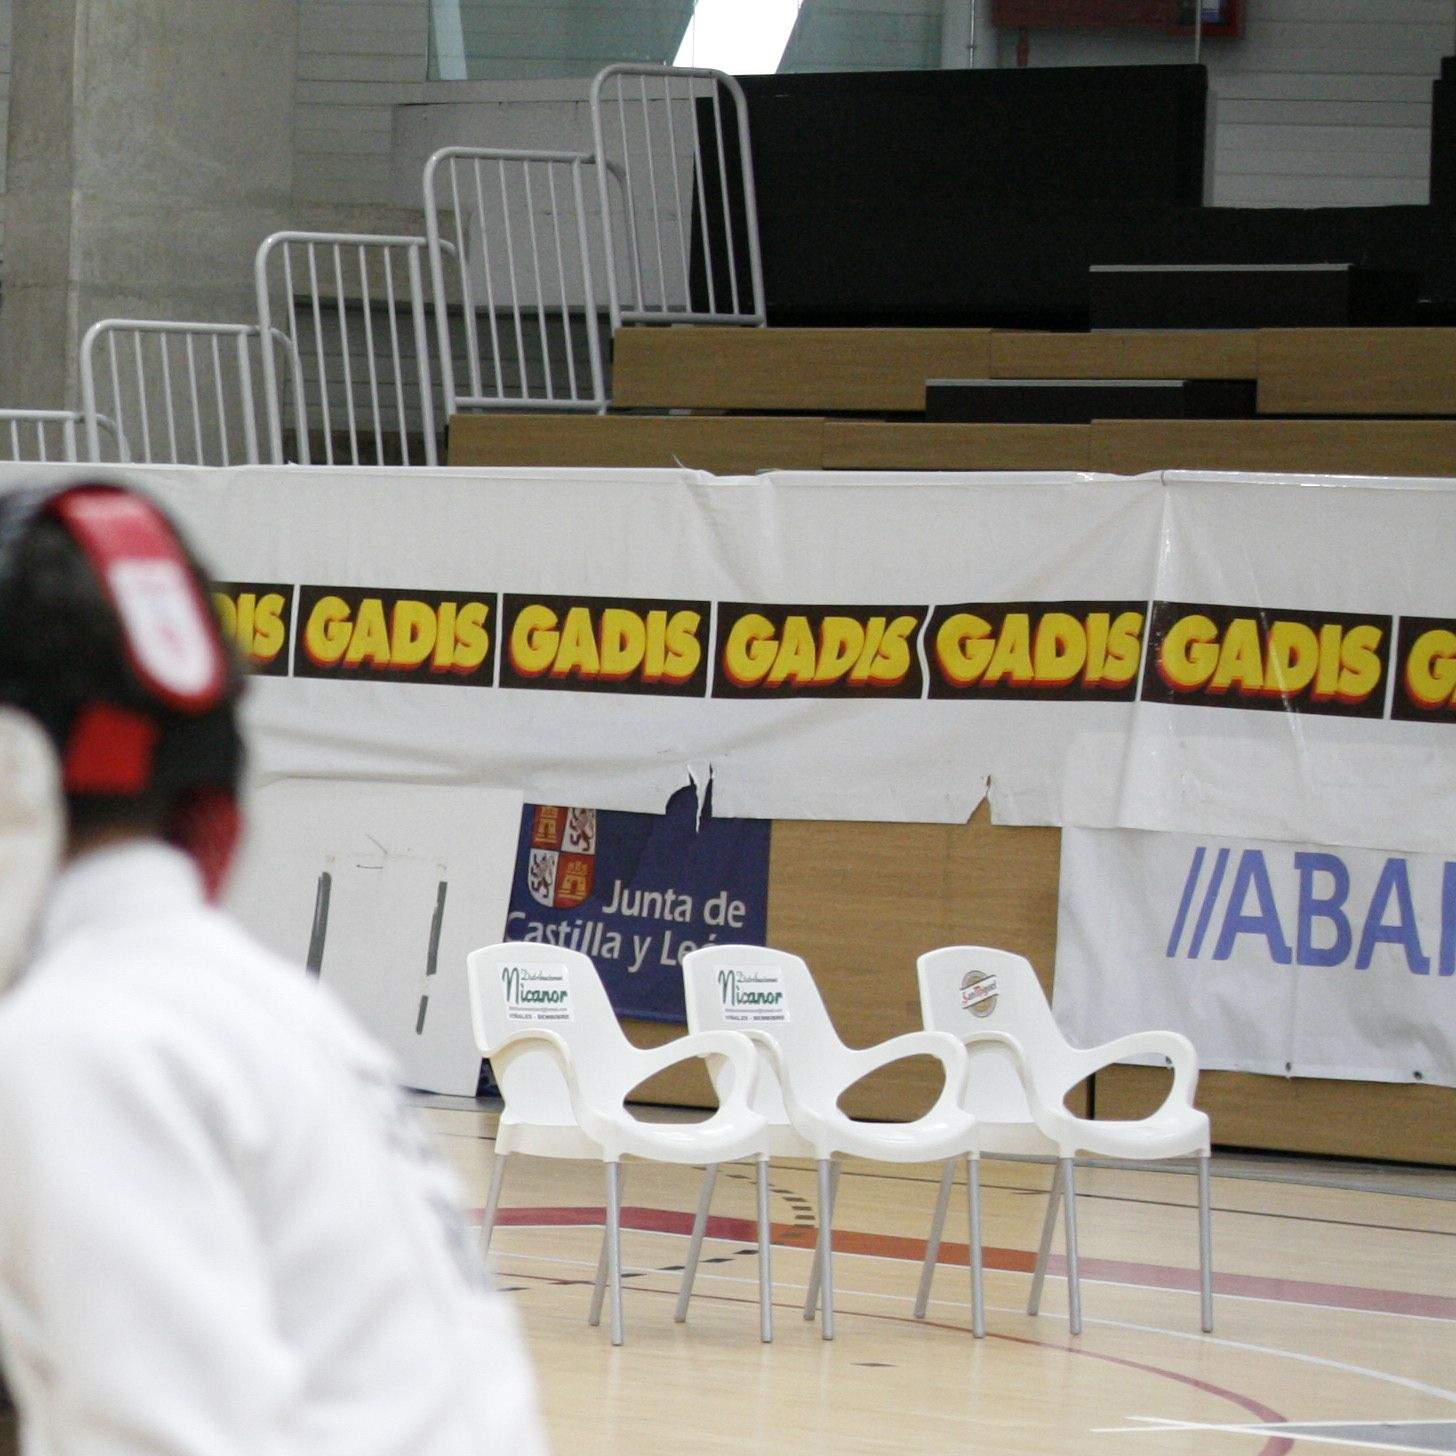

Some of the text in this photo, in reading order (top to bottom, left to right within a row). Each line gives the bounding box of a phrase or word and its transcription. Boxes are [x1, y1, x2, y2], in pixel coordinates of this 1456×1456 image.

[304, 596, 489, 673] GADIS
[509, 603, 701, 684] GADIS
[723, 613, 919, 689] GADIS
[933, 612, 1145, 689] GADIS
[1159, 617, 1385, 701] GADIS
[602, 880, 746, 928] Junta de
[628, 935, 652, 973] y
[660, 930, 718, 966] Le
[502, 966, 568, 1005] Nicanor
[718, 969, 783, 1006] Nicanor
